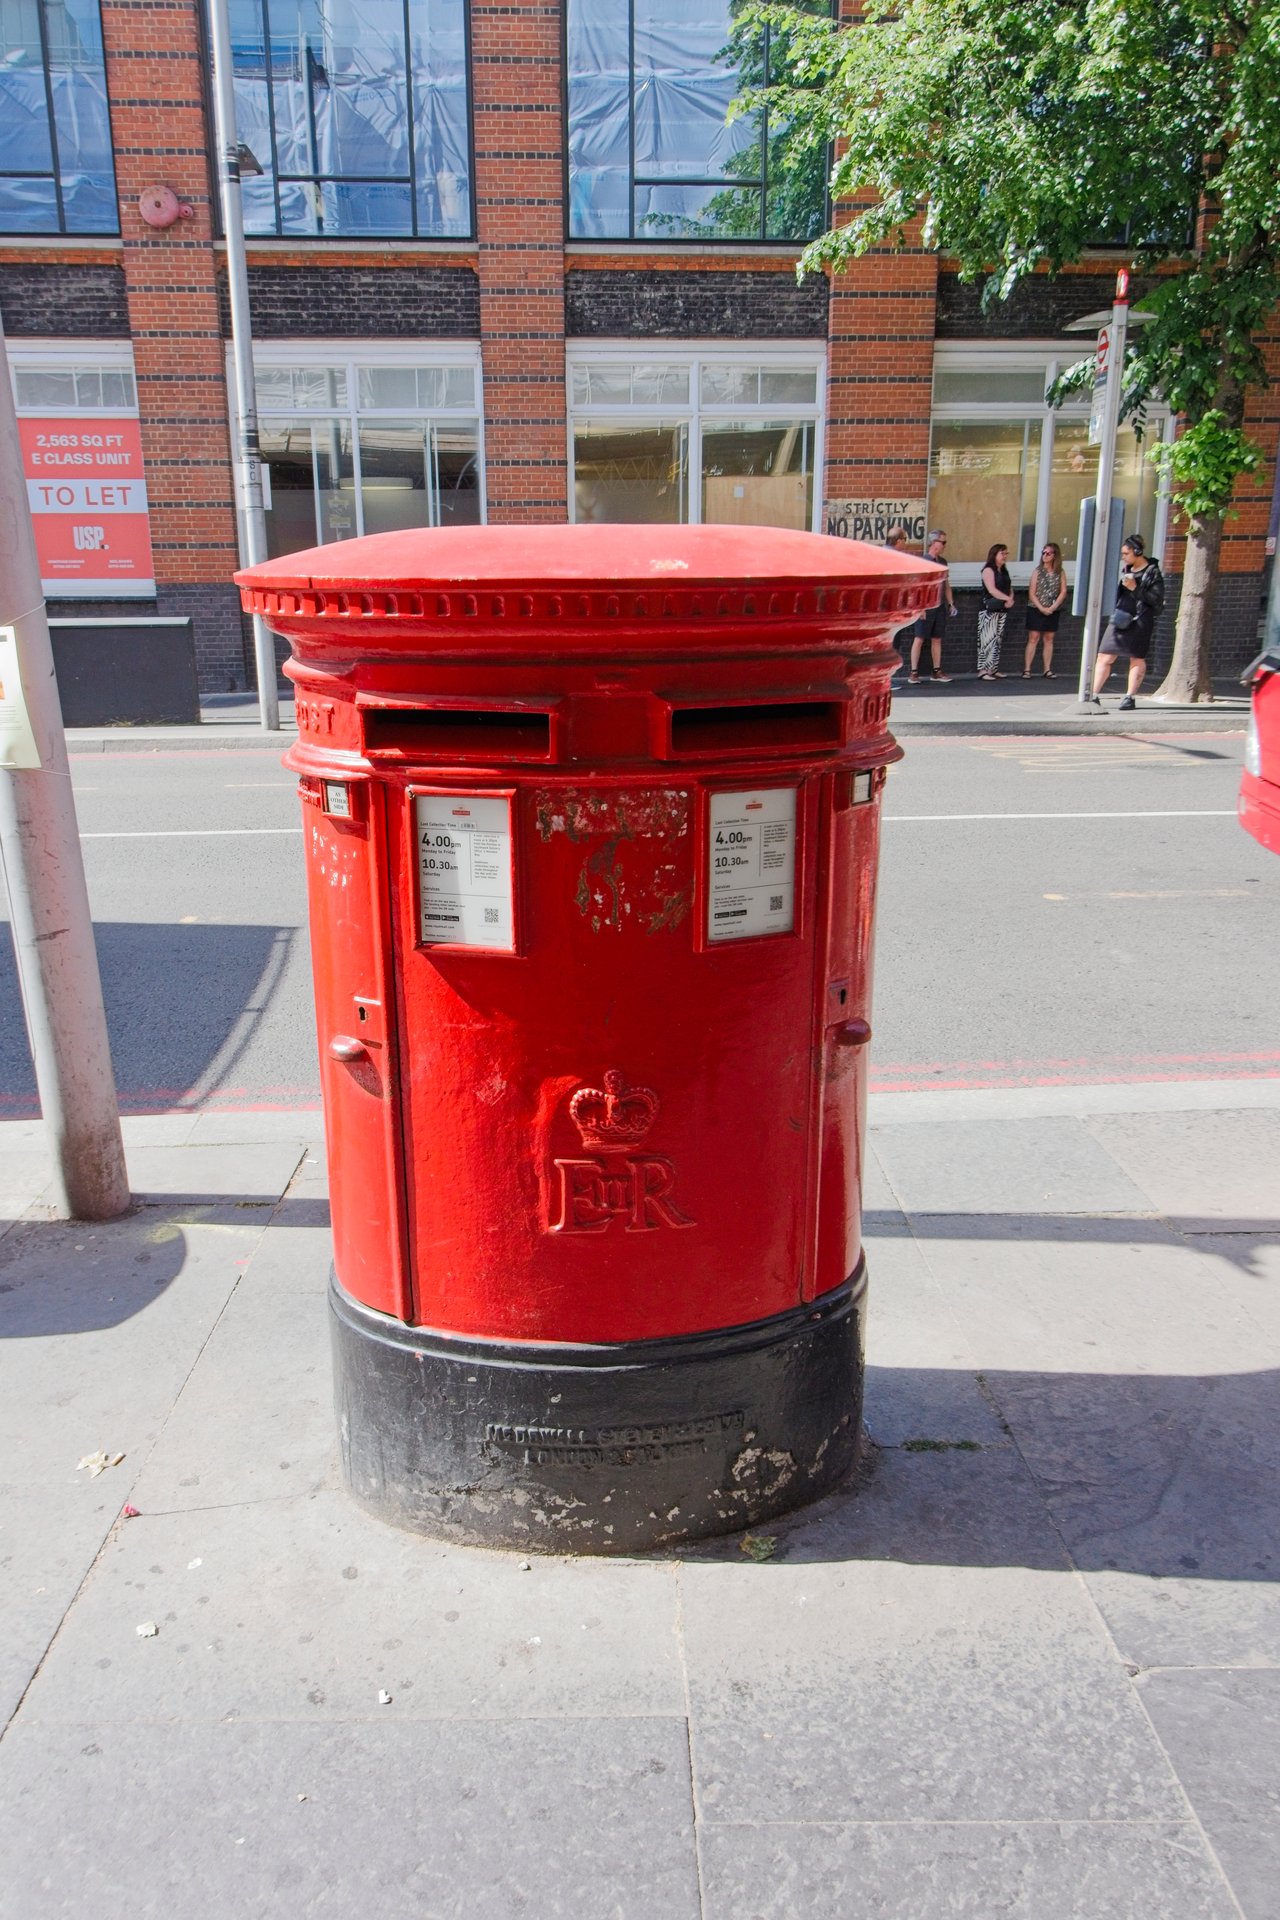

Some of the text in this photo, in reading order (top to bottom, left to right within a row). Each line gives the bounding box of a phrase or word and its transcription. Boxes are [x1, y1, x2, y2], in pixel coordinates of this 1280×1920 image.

[36, 434, 124, 448] 2,563 SQ FT
[31, 453, 131, 465] E CLASS UNIT
[38, 486, 132, 506] TO LET
[845, 502, 909, 514] STRICTLY
[827, 517, 848, 537] NO
[421, 832, 462, 848] 4.00pm
[715, 831, 753, 845] 4.00pm
[422, 858, 459, 871] 10.30am
[714, 856, 749, 868] 10.30am
